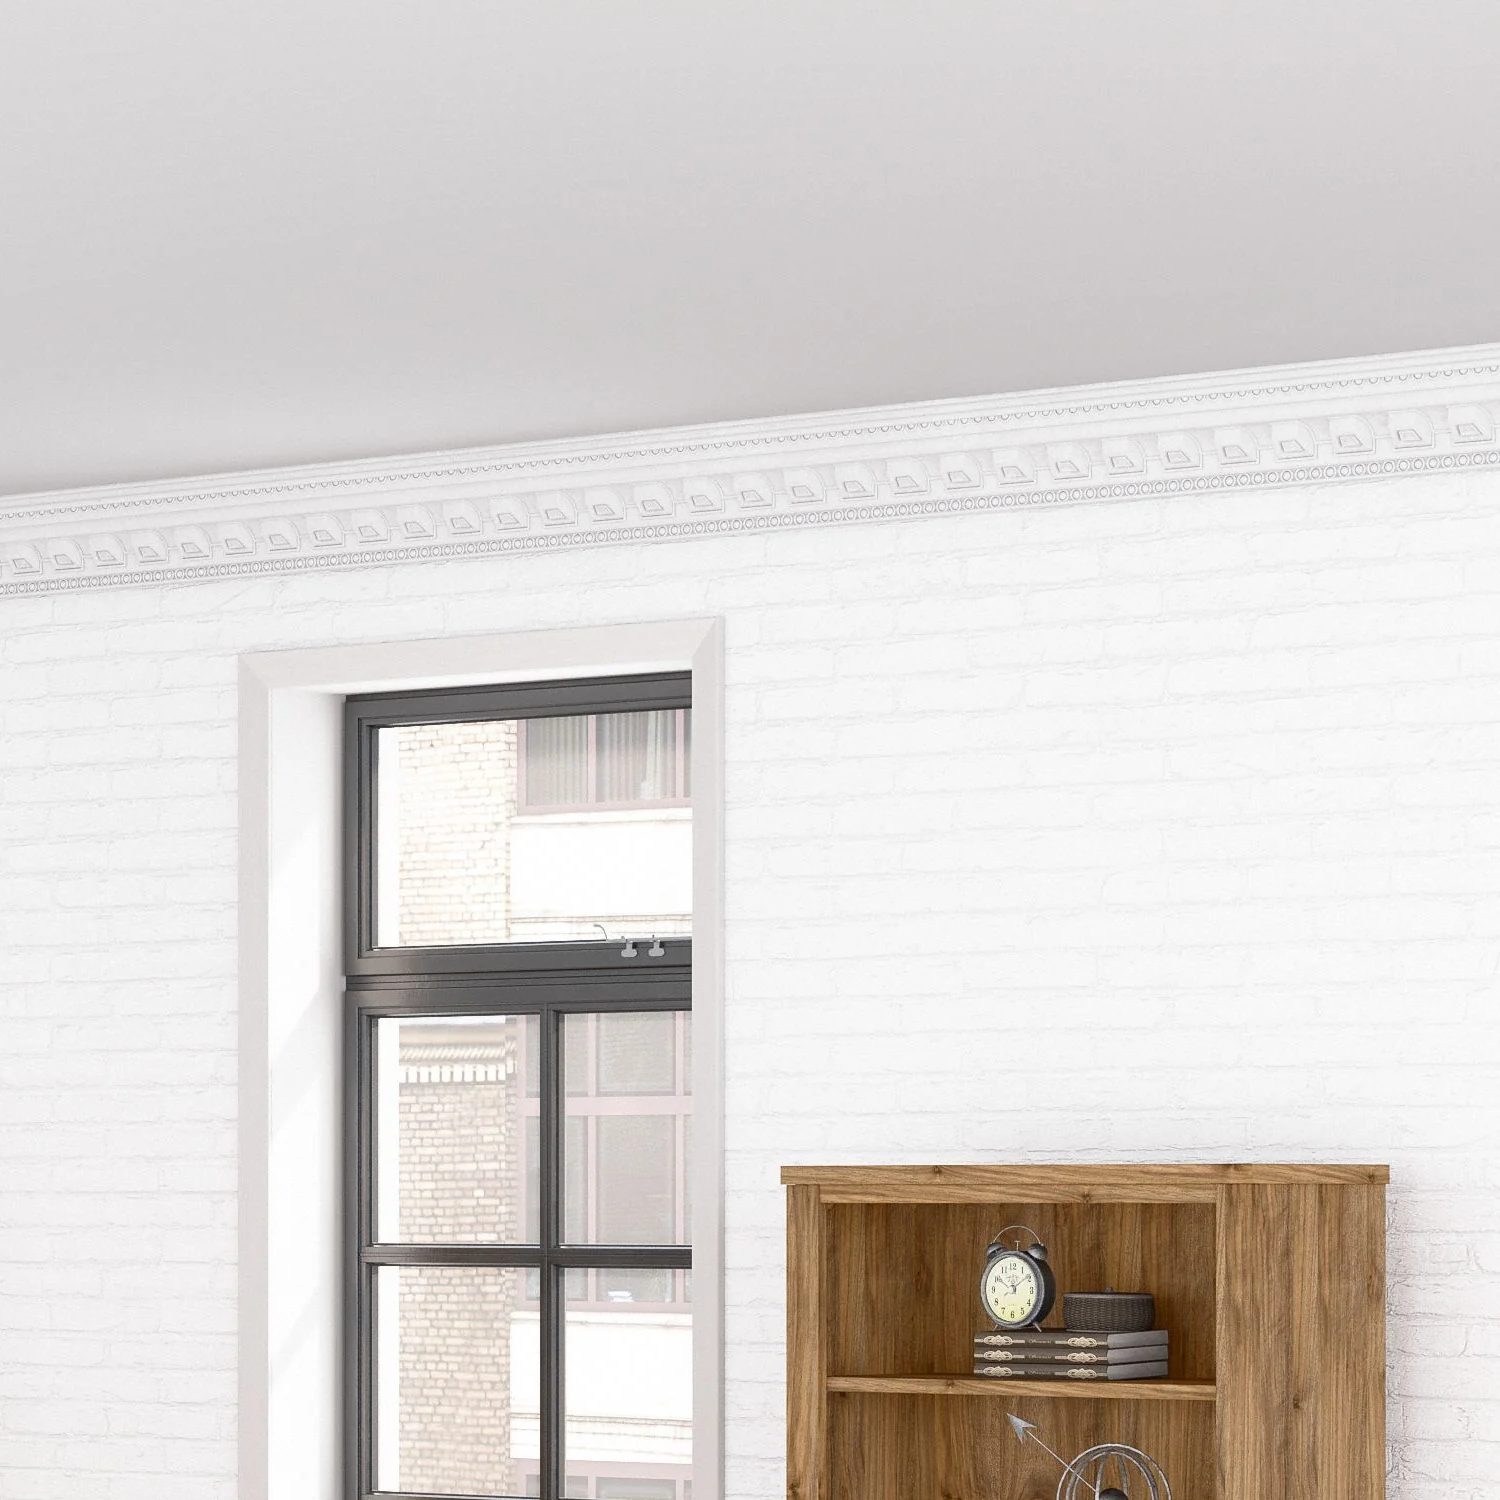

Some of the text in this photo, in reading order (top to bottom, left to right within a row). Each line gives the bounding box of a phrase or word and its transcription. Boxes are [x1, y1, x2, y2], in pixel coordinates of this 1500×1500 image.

[1001, 1266, 1008, 1274] 11
[1009, 1262, 1017, 1270] 12
[1021, 1266, 1024, 1274] 1
[1029, 1286, 1034, 1294] 3
[994, 1298, 999, 1306] 8
[1026, 1298, 1031, 1306] 4
[1010, 1310, 1015, 1318] 6
[1020, 1307, 1025, 1315] 5
